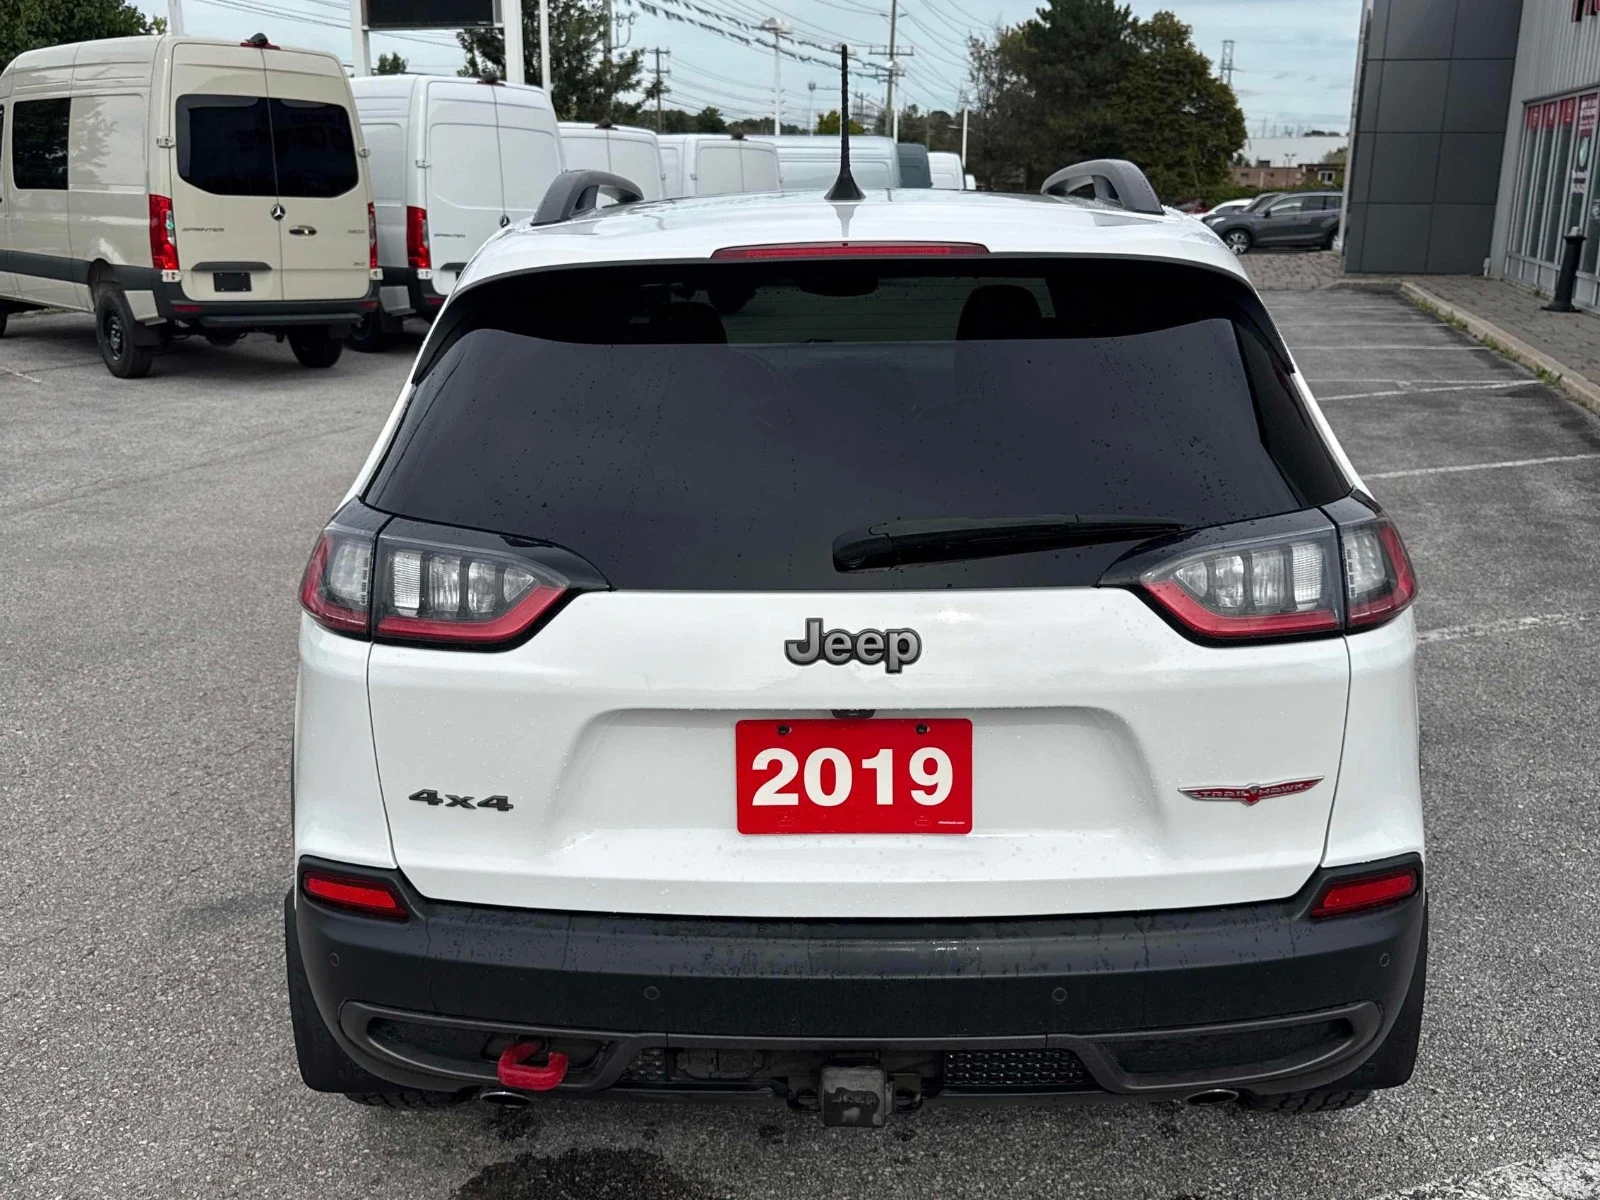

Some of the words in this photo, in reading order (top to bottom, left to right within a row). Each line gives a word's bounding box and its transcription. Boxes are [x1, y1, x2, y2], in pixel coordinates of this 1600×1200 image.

[784, 617, 922, 674] Jeep
[408, 788, 514, 812] 4x4
[752, 747, 953, 806] 2019
